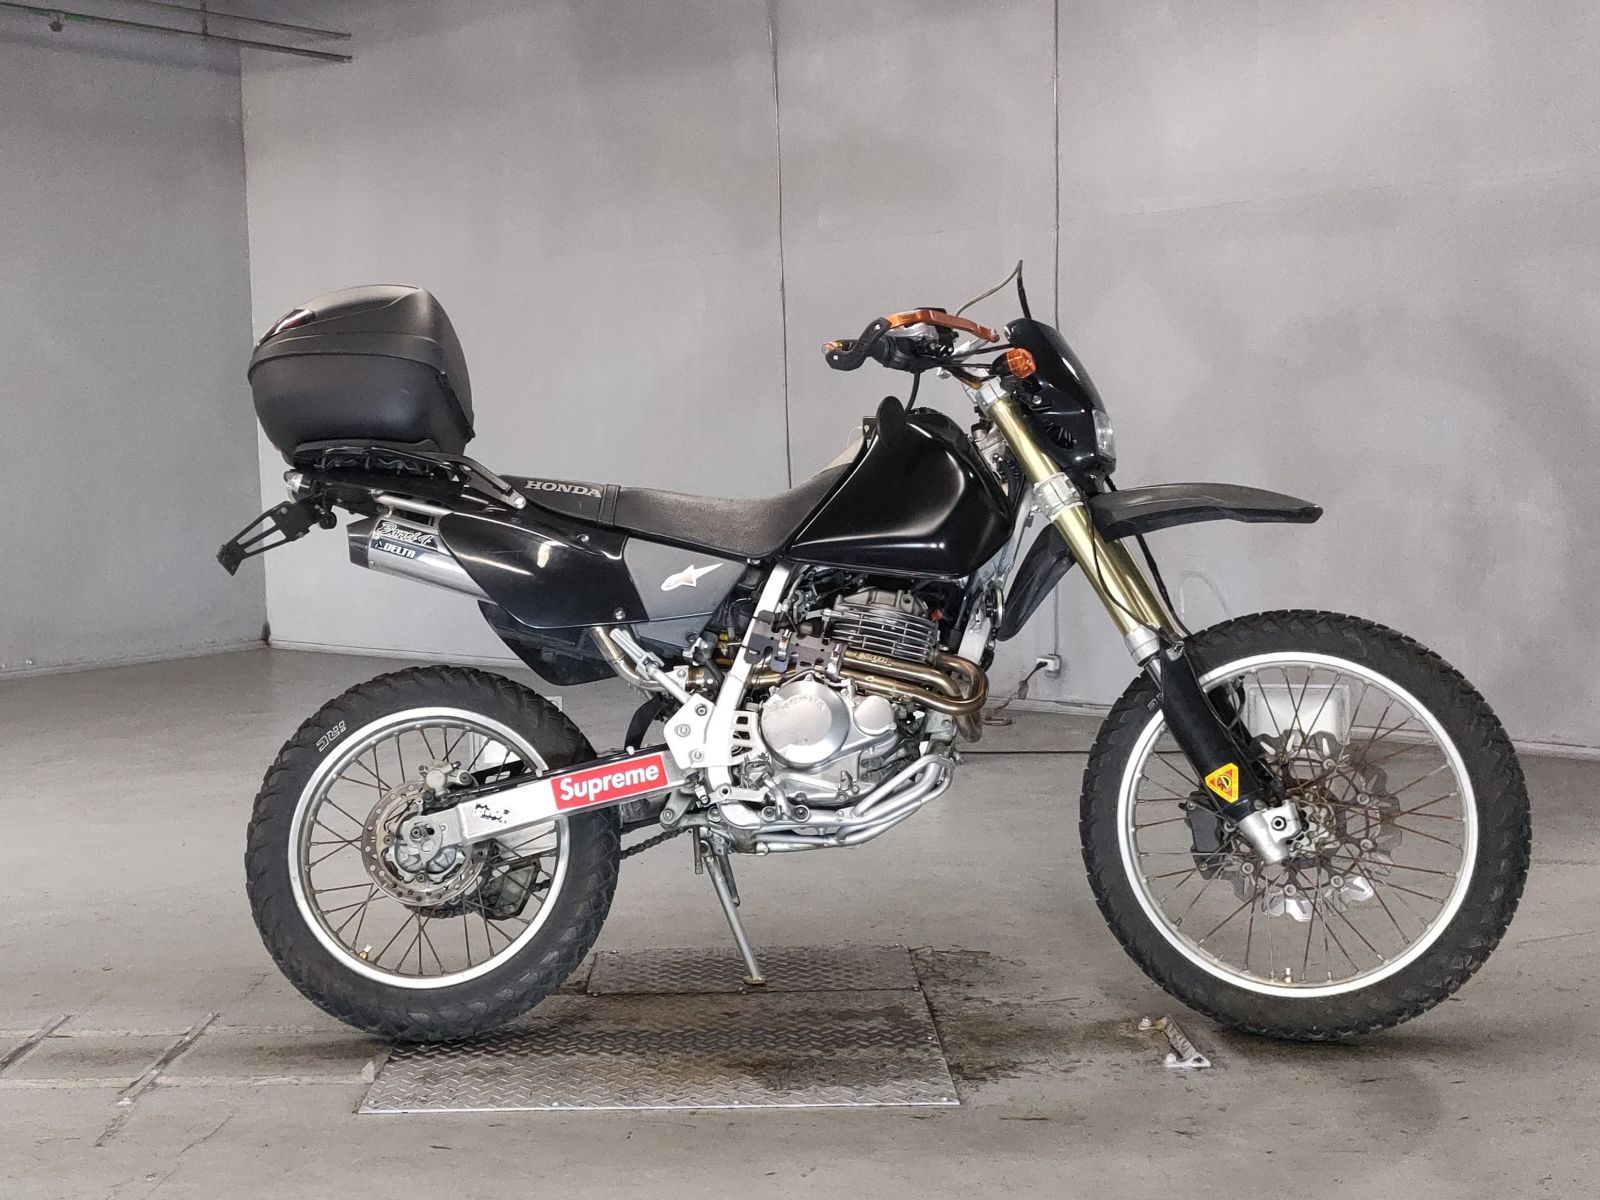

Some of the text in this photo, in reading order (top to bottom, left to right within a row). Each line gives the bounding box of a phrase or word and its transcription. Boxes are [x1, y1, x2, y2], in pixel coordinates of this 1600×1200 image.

[524, 480, 602, 498] HONDA
[383, 542, 417, 559] DELTA
[316, 720, 347, 752] IRC
[560, 765, 659, 801] Supreme
